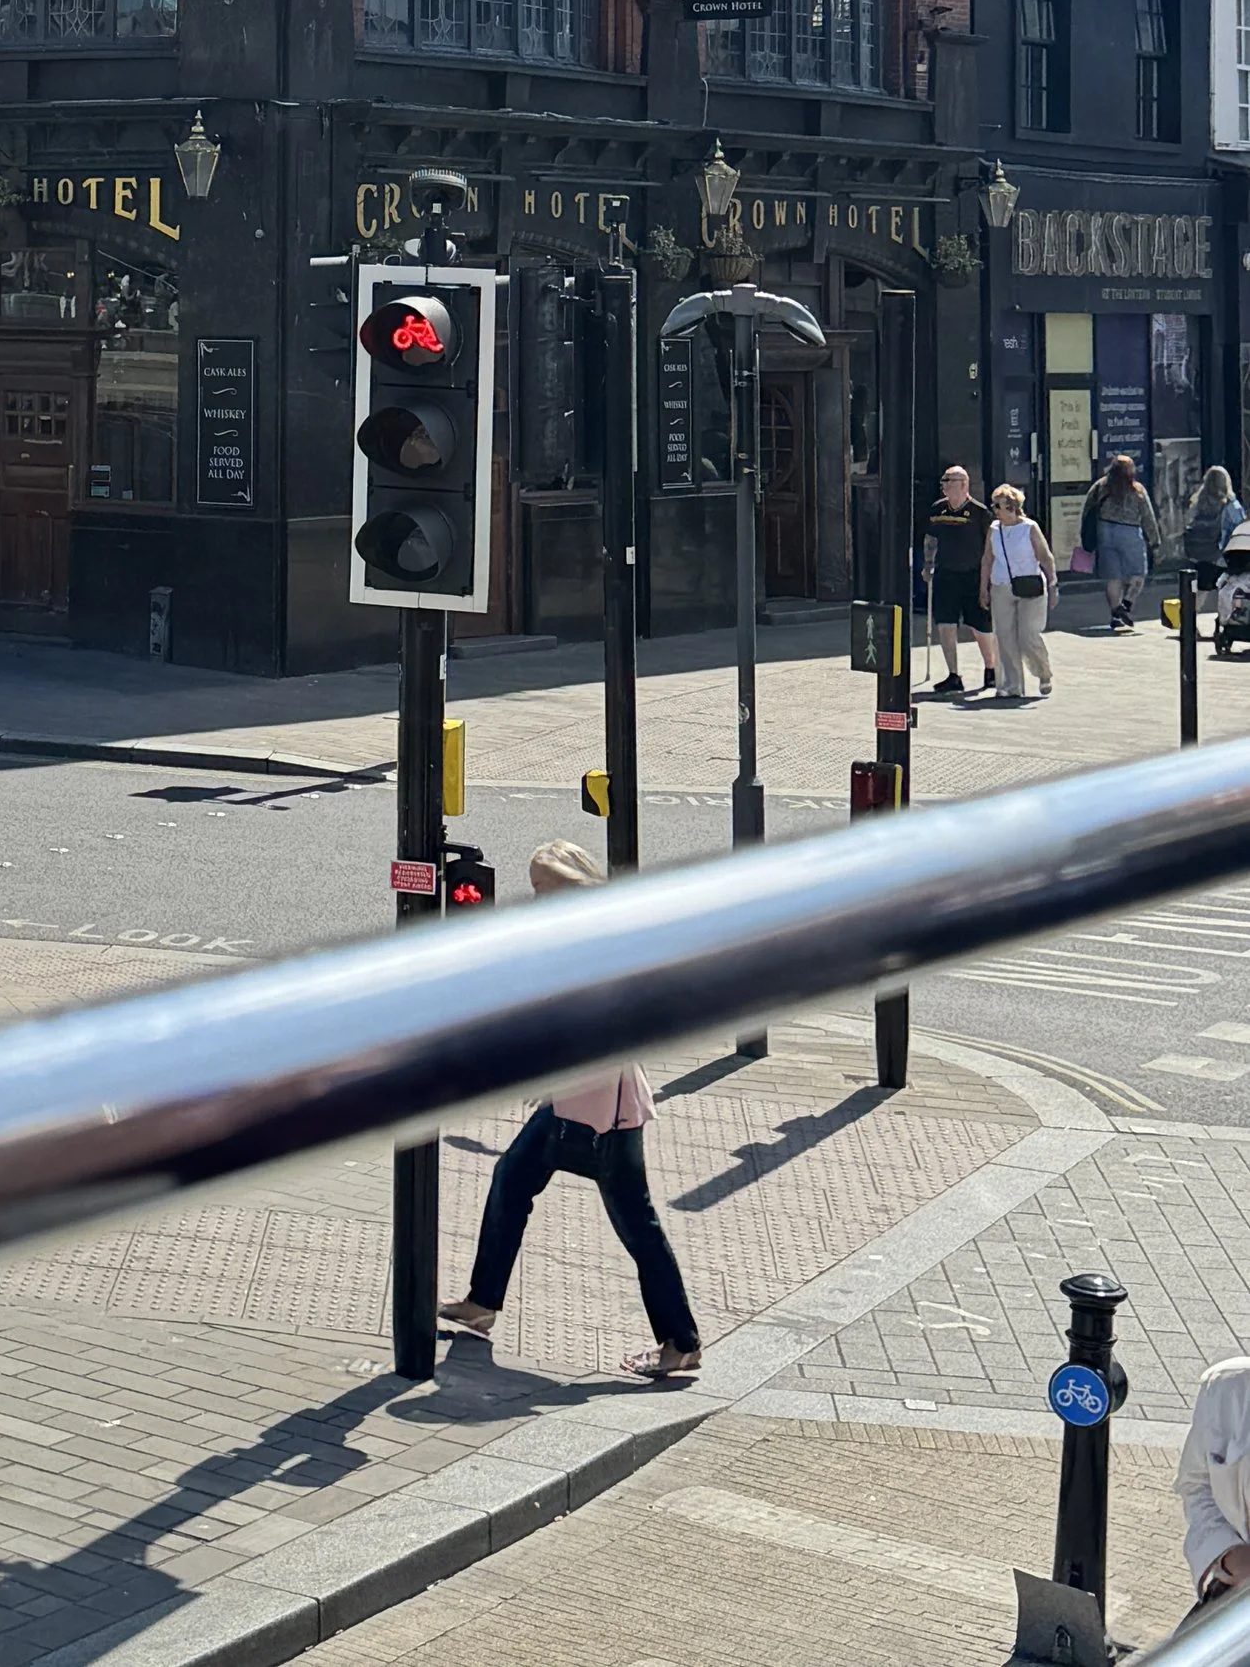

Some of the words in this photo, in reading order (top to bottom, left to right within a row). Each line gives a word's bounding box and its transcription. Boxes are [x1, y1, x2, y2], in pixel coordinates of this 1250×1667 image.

[692, 2, 728, 13] CROWN
[731, 1, 764, 11] HOTEL
[33, 176, 181, 241] HOTEL
[356, 182, 479, 239] CRN
[828, 203, 929, 259] HOTEL
[1012, 209, 1214, 278] BACKSTAGE
[203, 367, 226, 377] CASK
[227, 368, 247, 377] ALES
[203, 407, 247, 420] WHISKEY
[213, 446, 240, 456] FOOD
[209, 457, 244, 468] SERVED
[208, 469, 223, 479] ALL
[226, 469, 245, 480] DAY
[67, 923, 255, 953] LOOK
